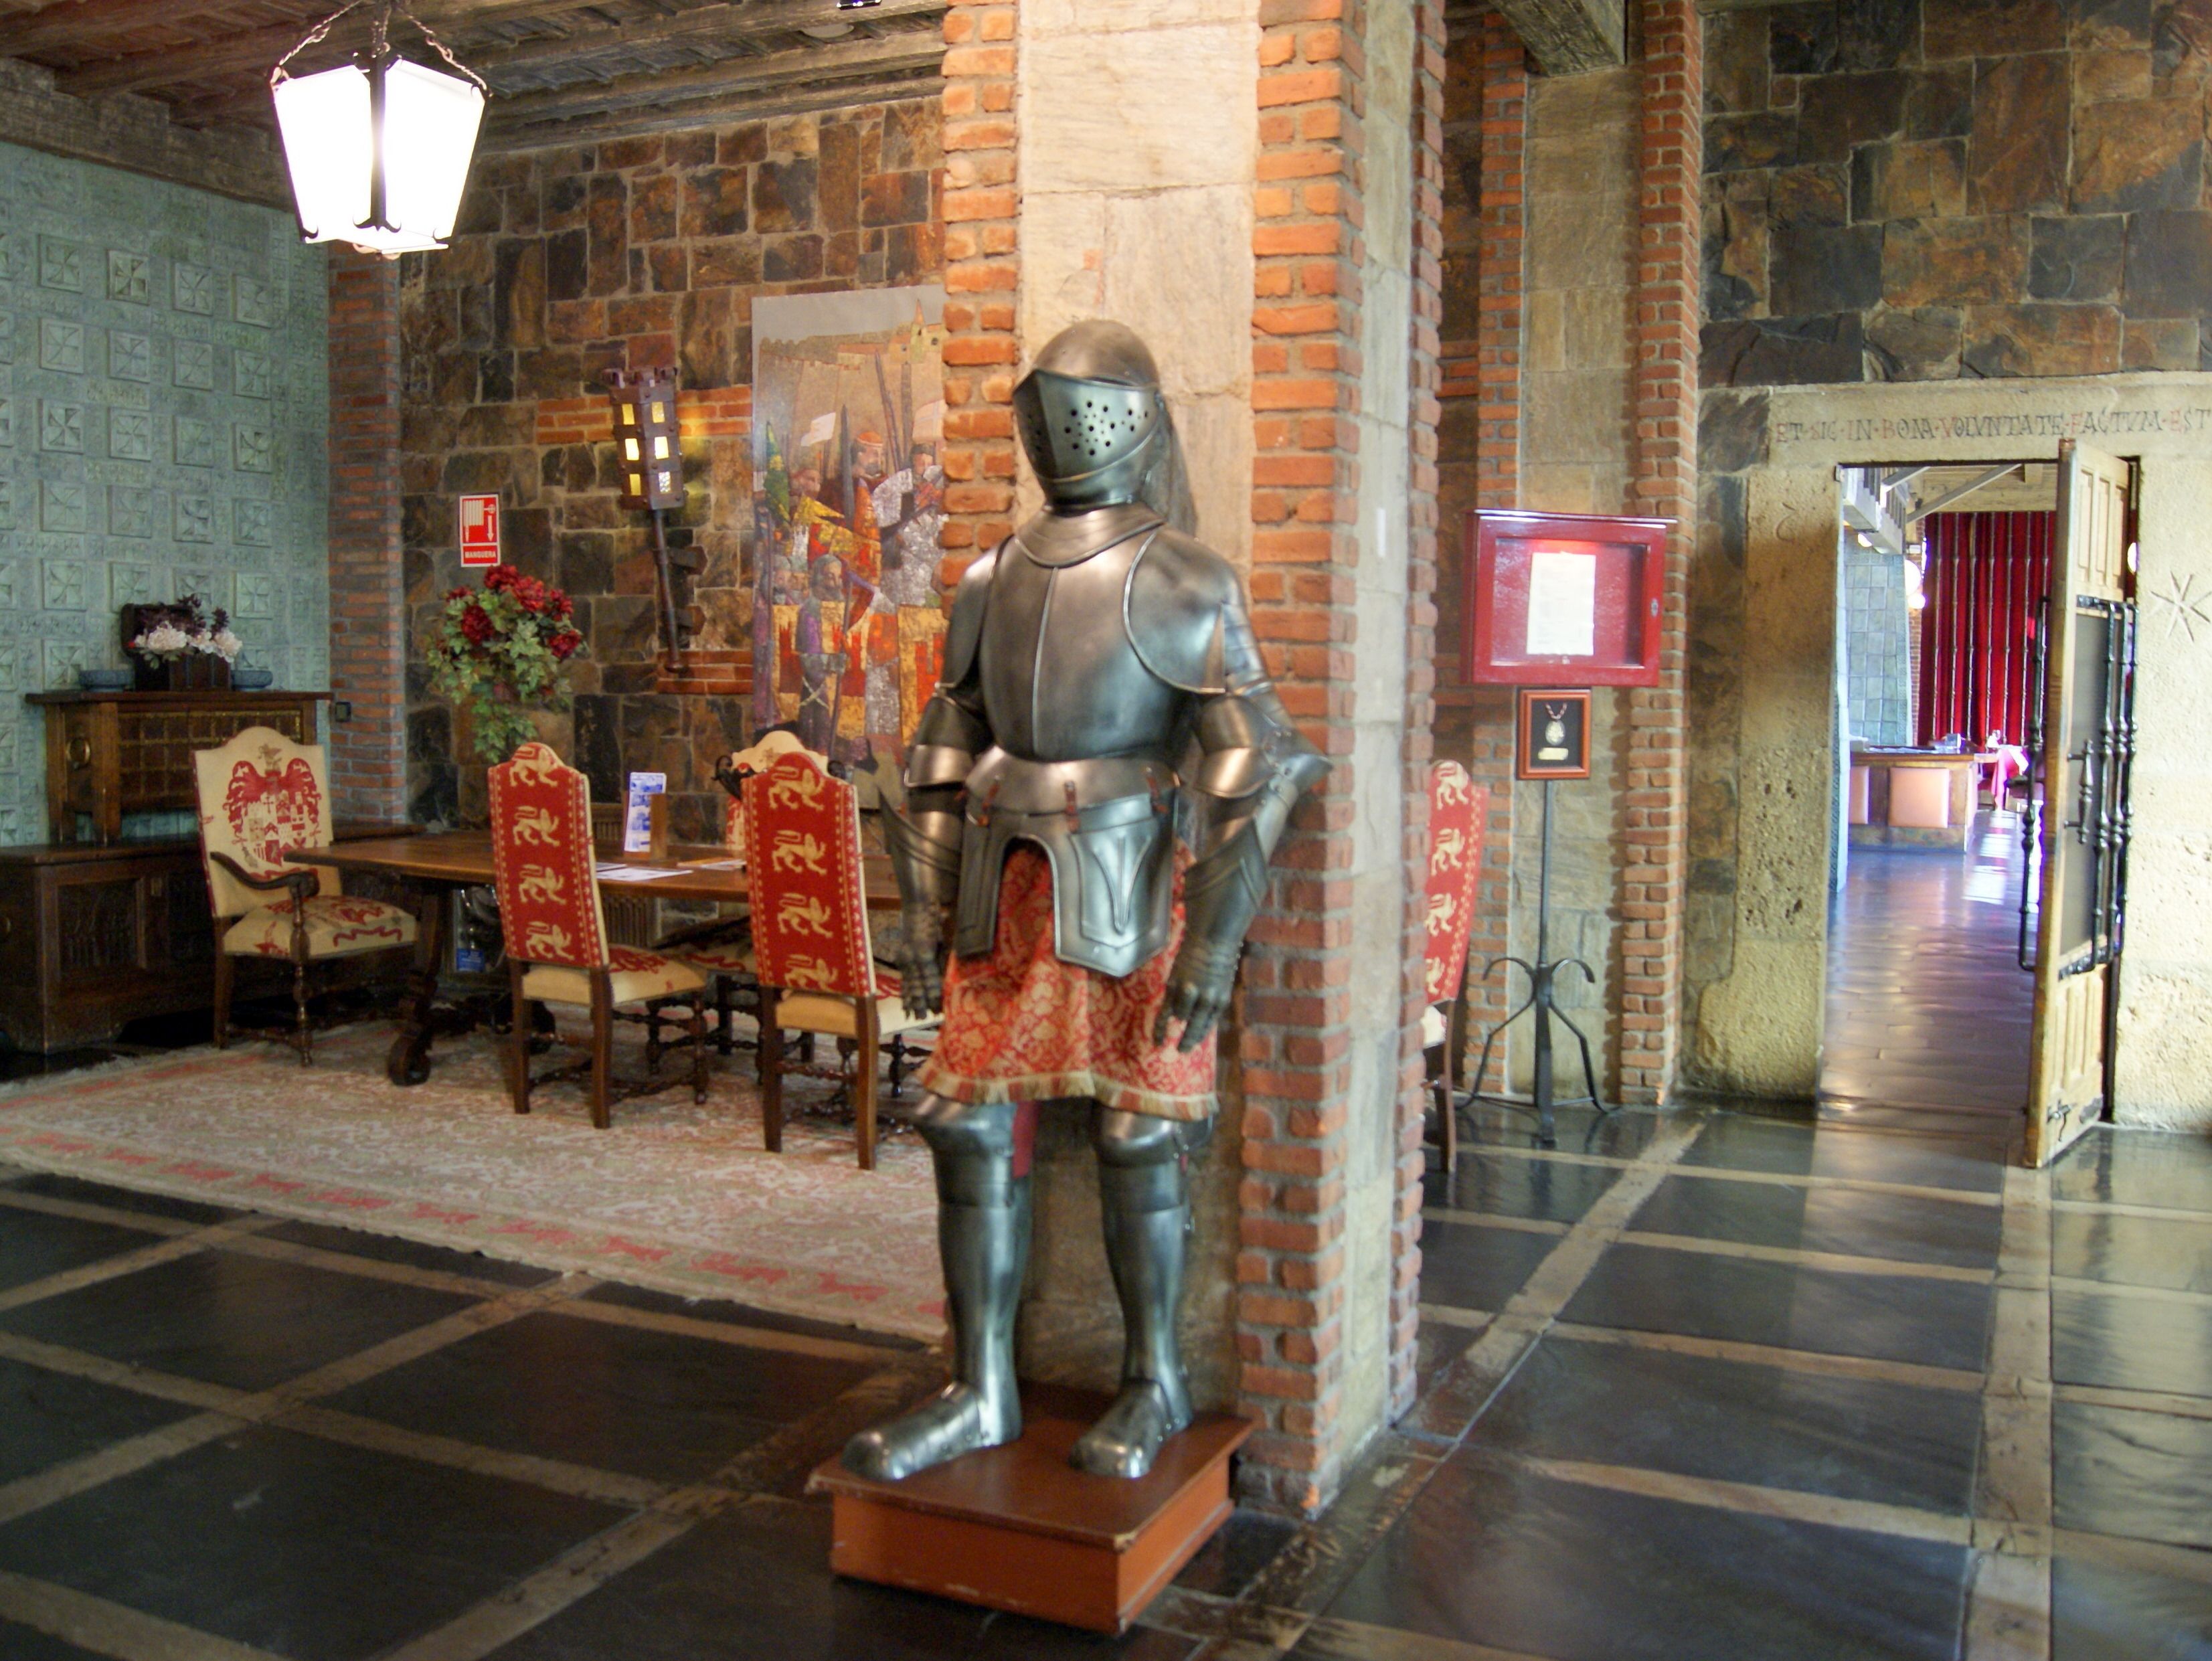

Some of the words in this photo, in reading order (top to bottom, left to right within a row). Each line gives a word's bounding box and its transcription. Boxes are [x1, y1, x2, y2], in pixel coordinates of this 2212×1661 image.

[1776, 422, 1803, 442] ET
[1847, 419, 1873, 441] IN
[2171, 406, 2211, 434] EST
